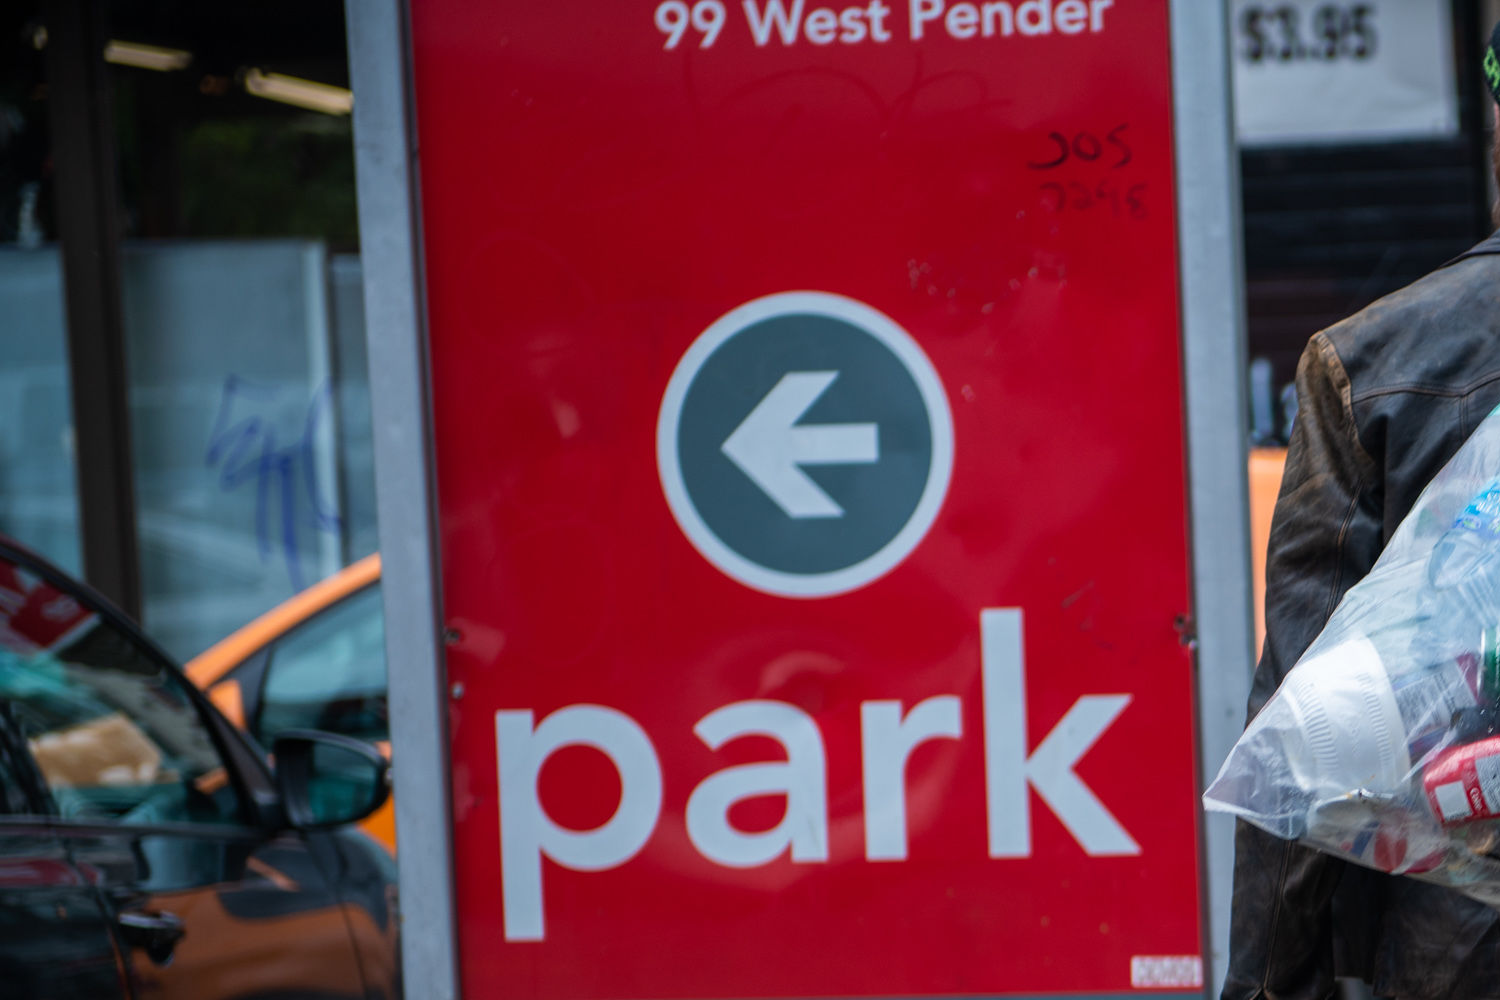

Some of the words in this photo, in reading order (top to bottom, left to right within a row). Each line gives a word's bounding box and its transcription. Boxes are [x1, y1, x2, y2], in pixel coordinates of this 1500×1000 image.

[655, 0, 726, 50] 99
[742, 0, 892, 48] West
[908, 0, 1115, 42] Pender
[495, 607, 1142, 942] park
